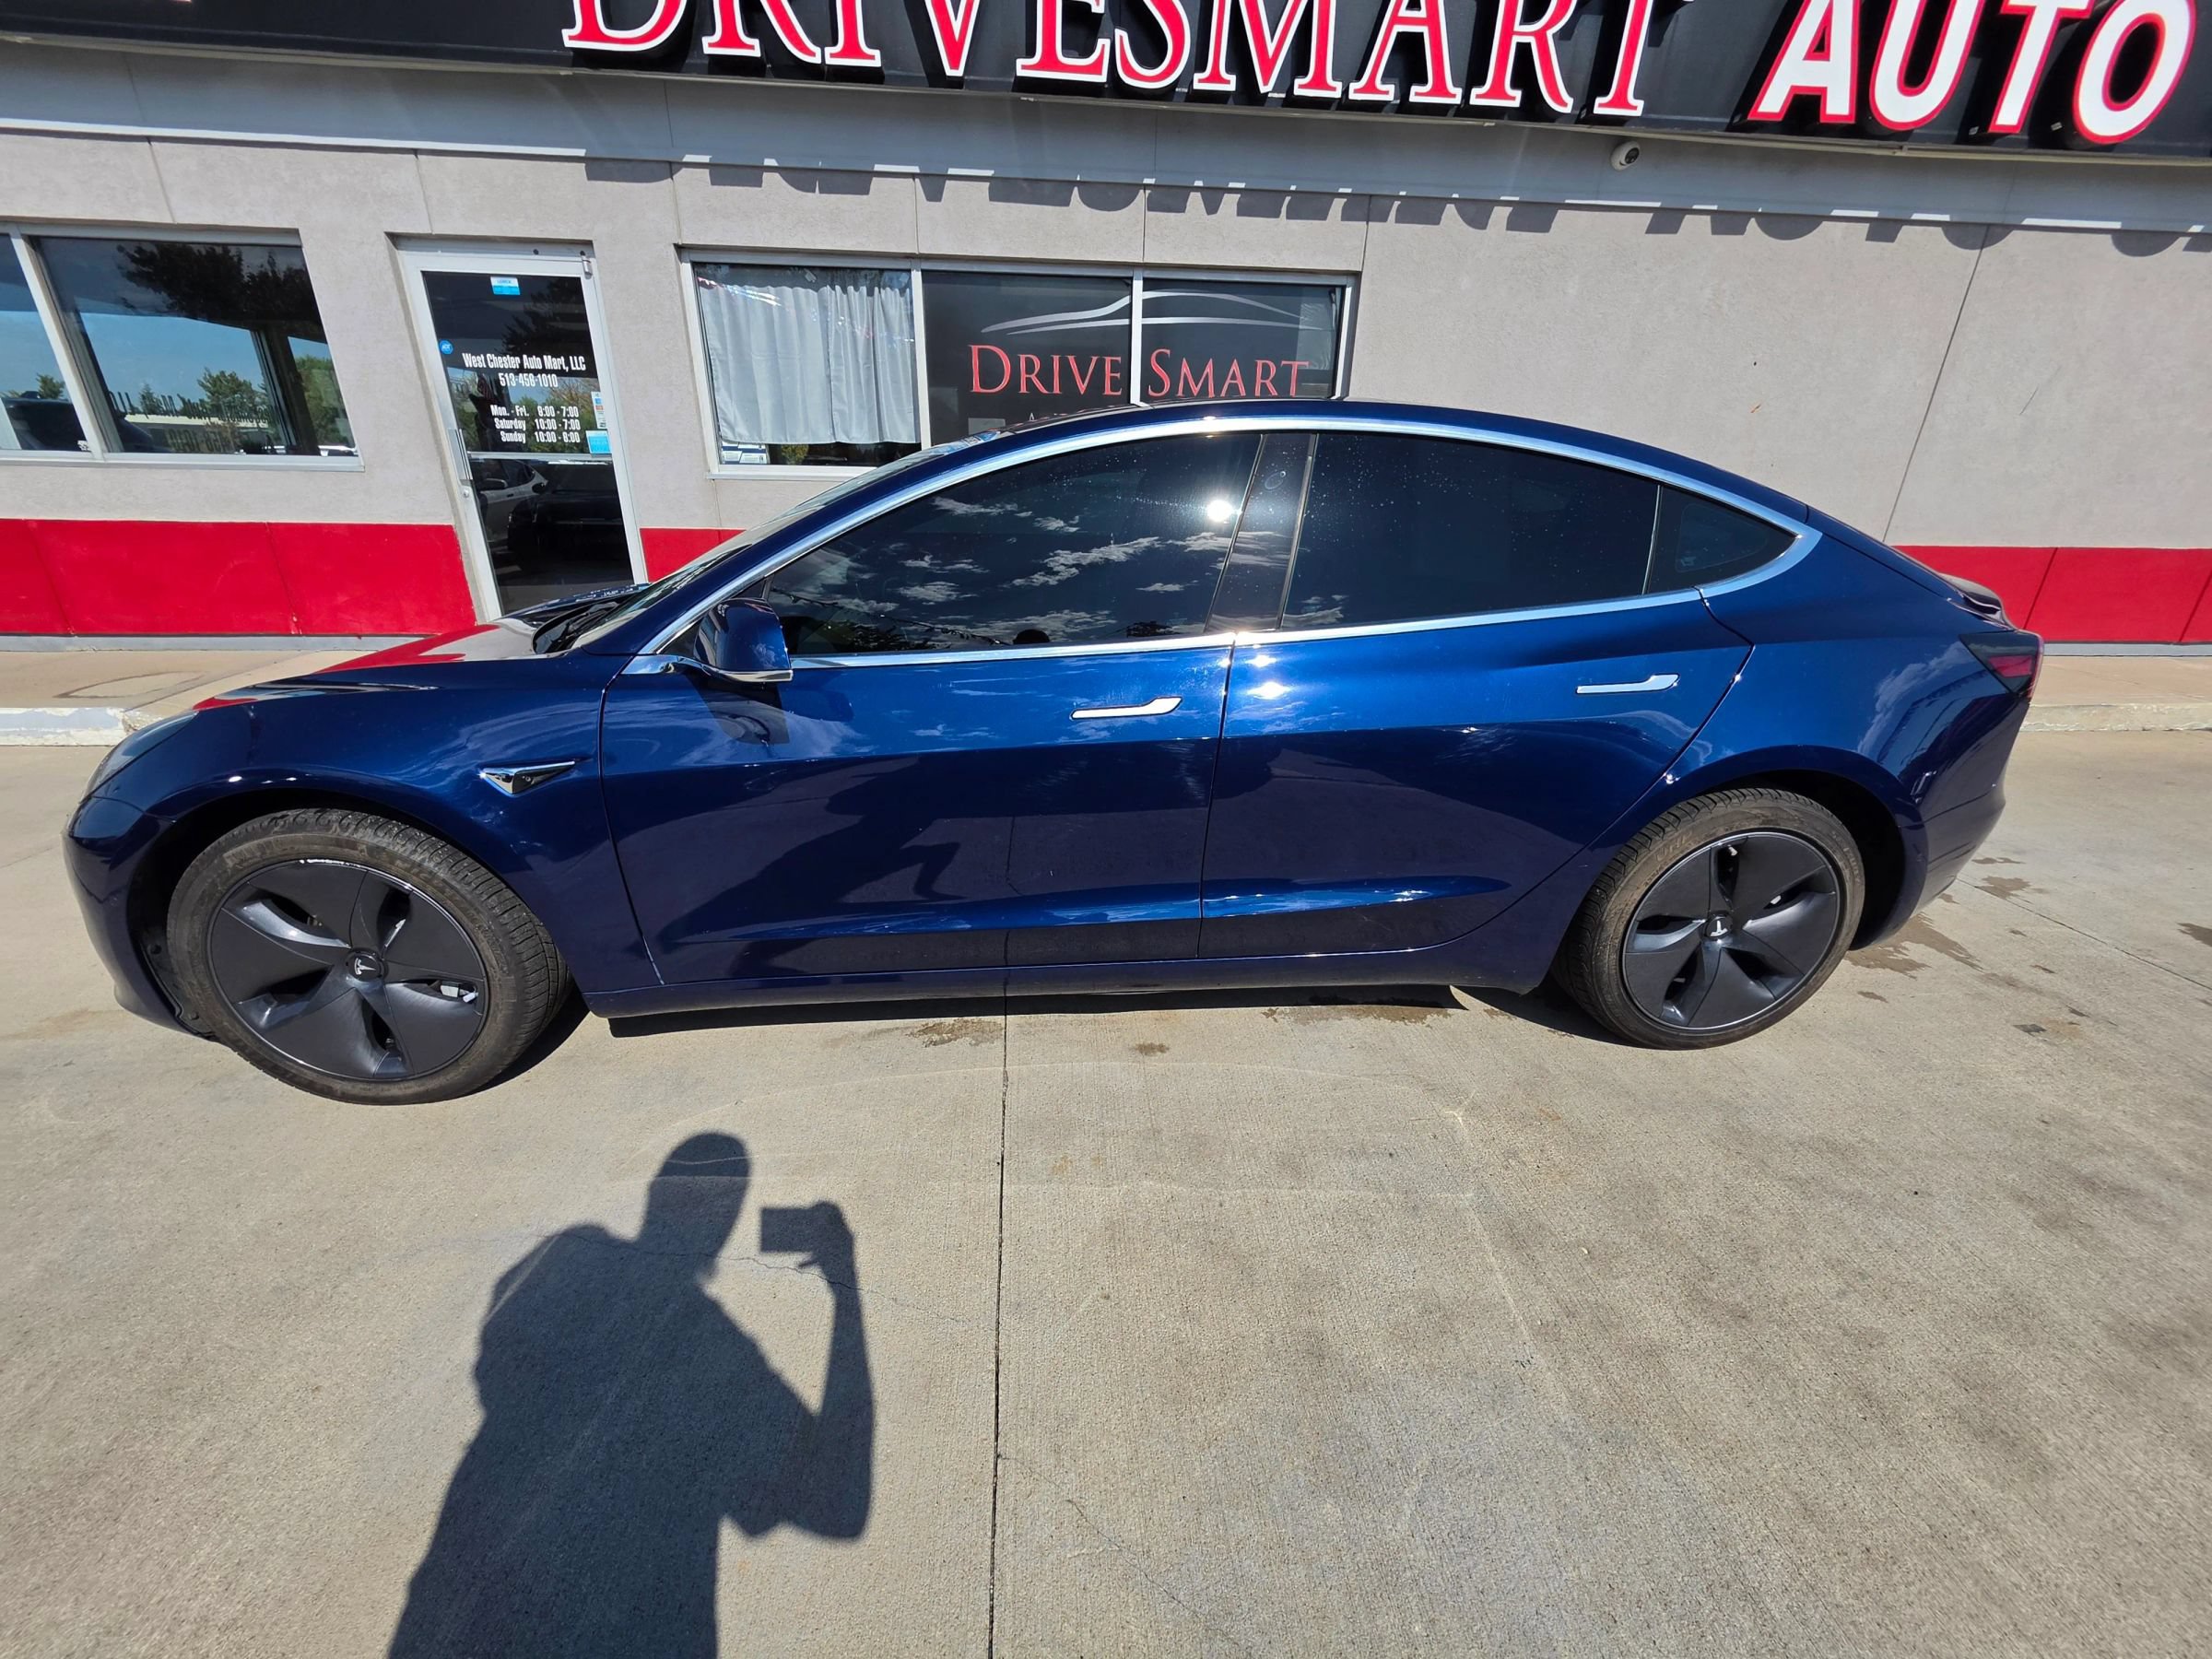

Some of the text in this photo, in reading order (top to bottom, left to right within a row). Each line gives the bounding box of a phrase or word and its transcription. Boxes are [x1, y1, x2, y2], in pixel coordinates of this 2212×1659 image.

[1747, 0, 2197, 146] AUTO
[462, 353, 586, 372] West Chester Auto Mart, LLC
[968, 344, 1310, 398] DRIVE SMART
[490, 405, 510, 417] Mon.
[560, 406, 579, 417] 7:00
[494, 418, 526, 430] Saturday
[535, 418, 557, 429] 10:00
[562, 419, 581, 430] 7:00
[500, 431, 526, 443] Sunday
[535, 431, 557, 442] 10:00
